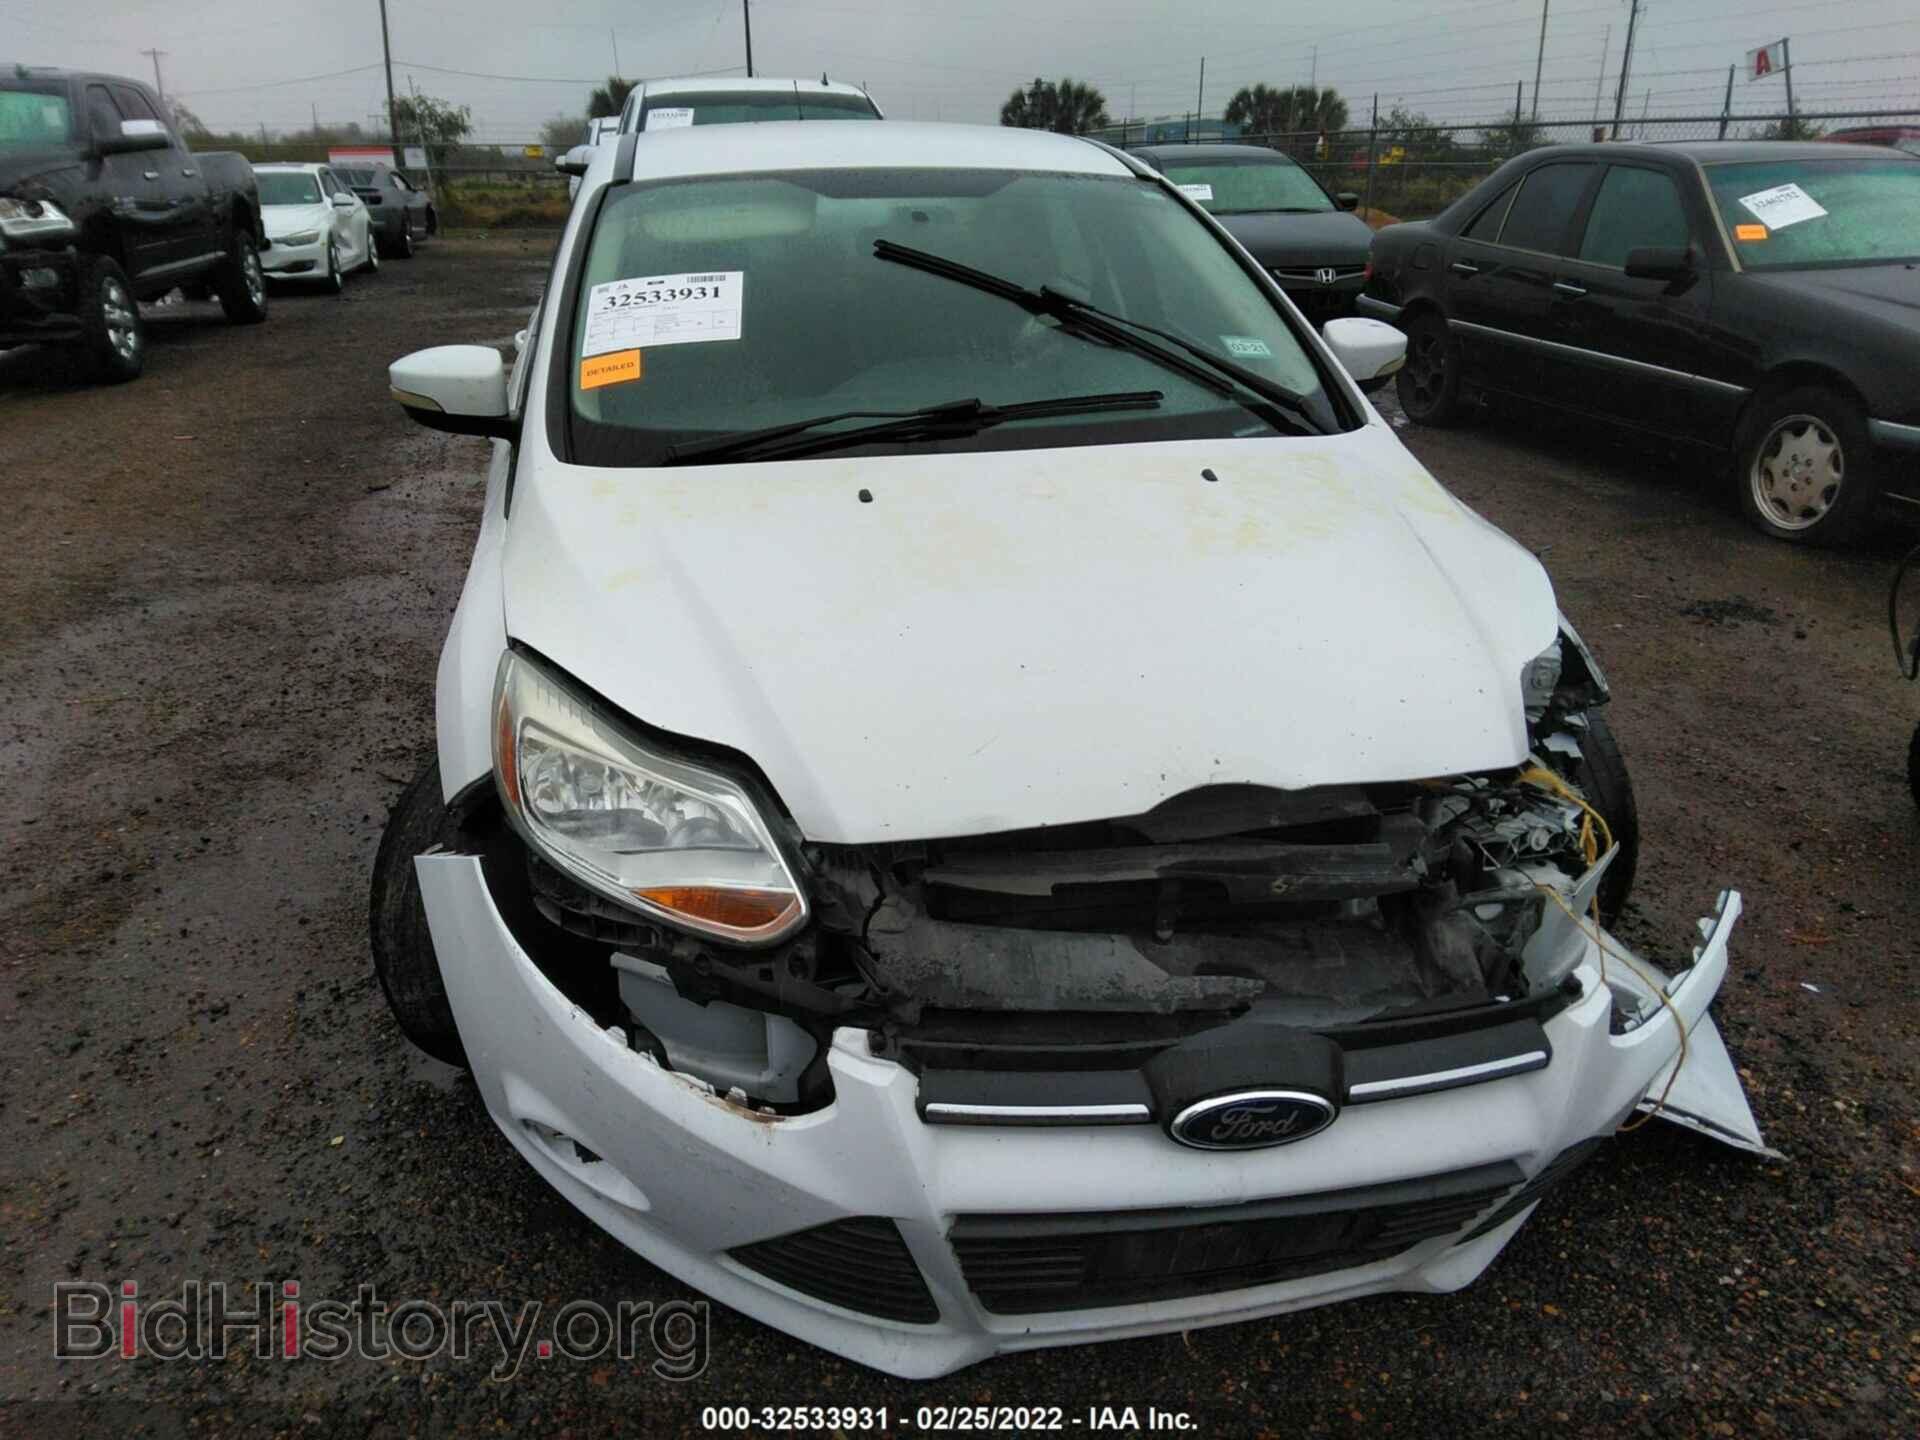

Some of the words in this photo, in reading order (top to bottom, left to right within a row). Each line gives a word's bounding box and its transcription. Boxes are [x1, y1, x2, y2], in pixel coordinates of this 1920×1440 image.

[1755, 47, 1772, 76] A
[602, 286, 721, 311] 32533931
[586, 361, 634, 377] DETAILED
[1211, 1104, 1299, 1140] Ford
